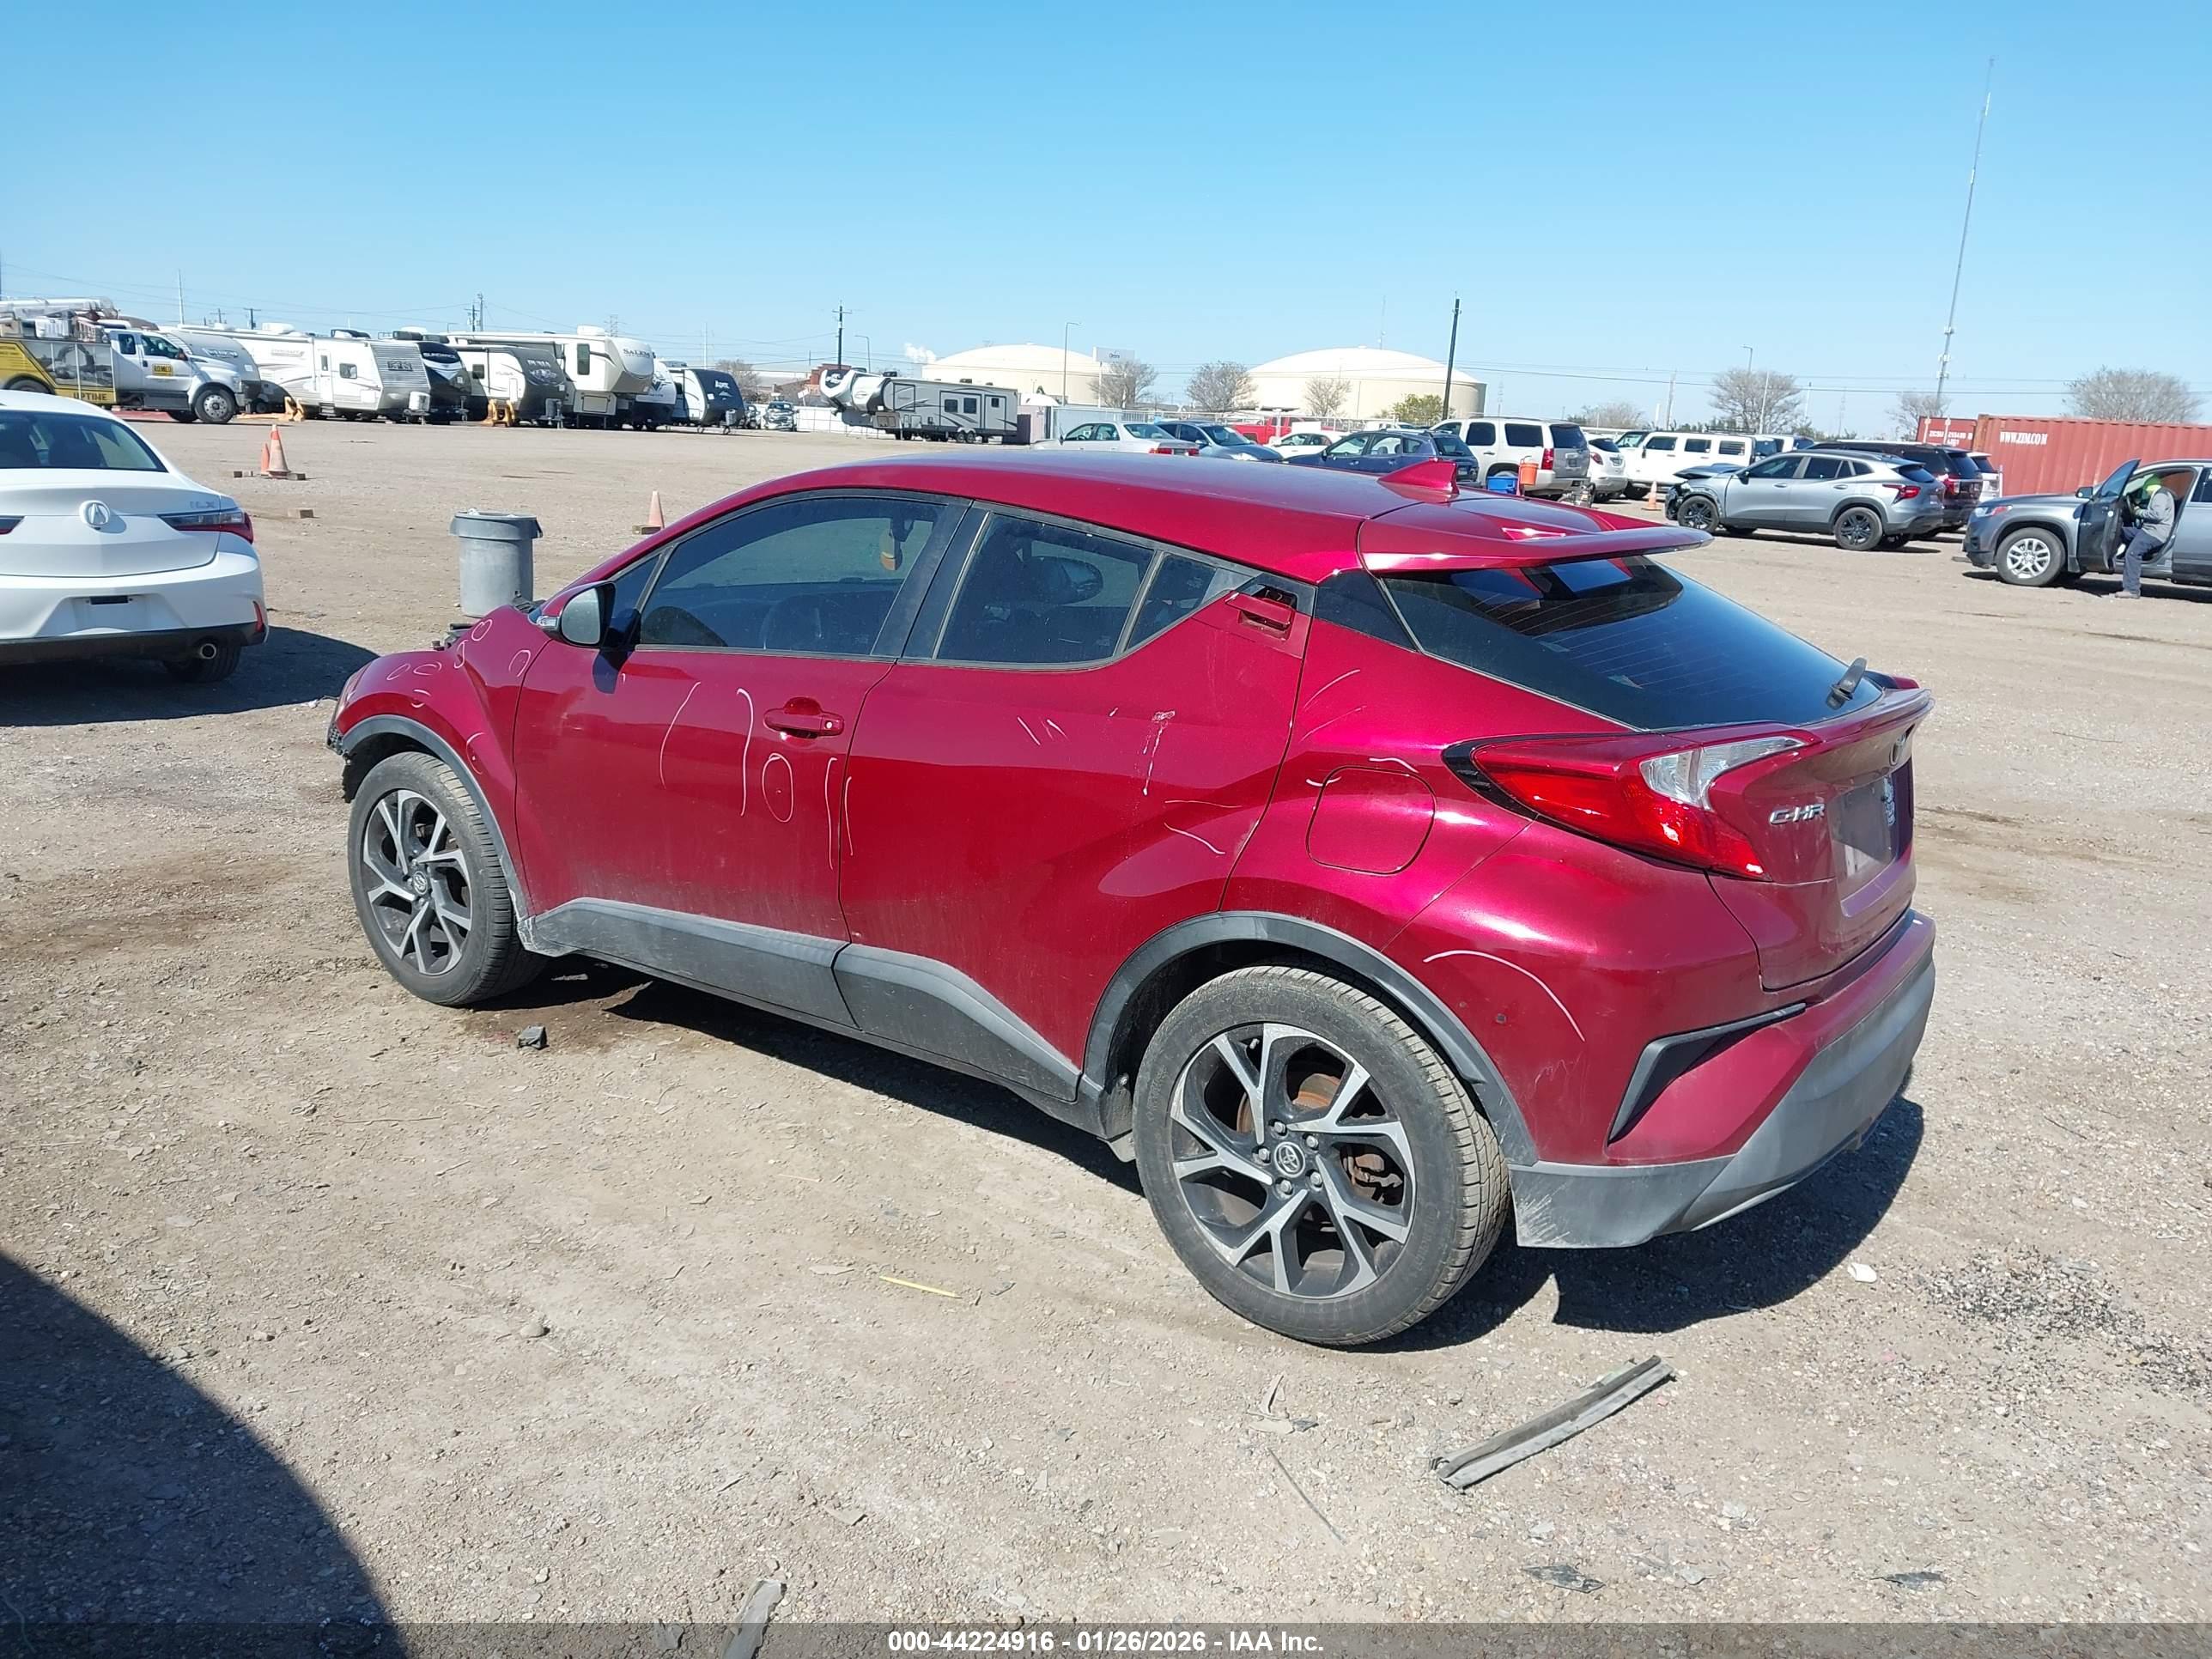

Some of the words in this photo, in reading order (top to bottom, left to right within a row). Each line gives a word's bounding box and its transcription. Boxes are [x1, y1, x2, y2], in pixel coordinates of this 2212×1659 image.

[623, 349, 650, 358] SALEM
[1999, 431, 2048, 446] WWW.ZIM.COM
[1769, 803, 1826, 825] C-HR
